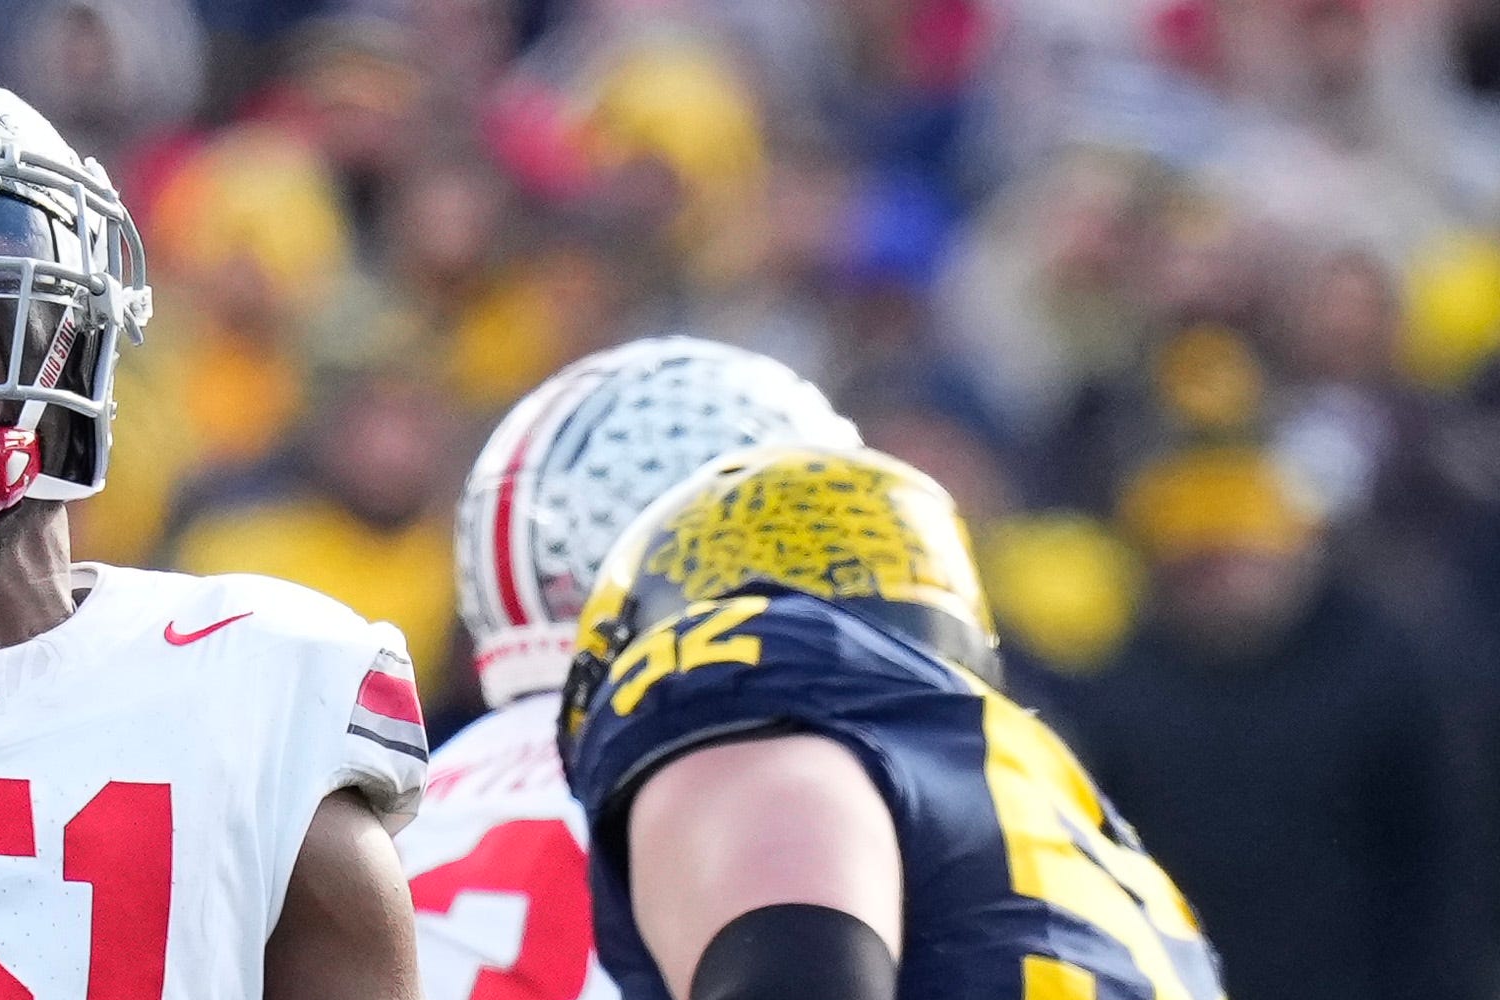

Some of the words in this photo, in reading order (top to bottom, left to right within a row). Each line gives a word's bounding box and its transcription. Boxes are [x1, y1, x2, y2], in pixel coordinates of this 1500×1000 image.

[39, 355, 62, 389] OHIO
[53, 317, 78, 360] STATE
[609, 595, 772, 718] 52
